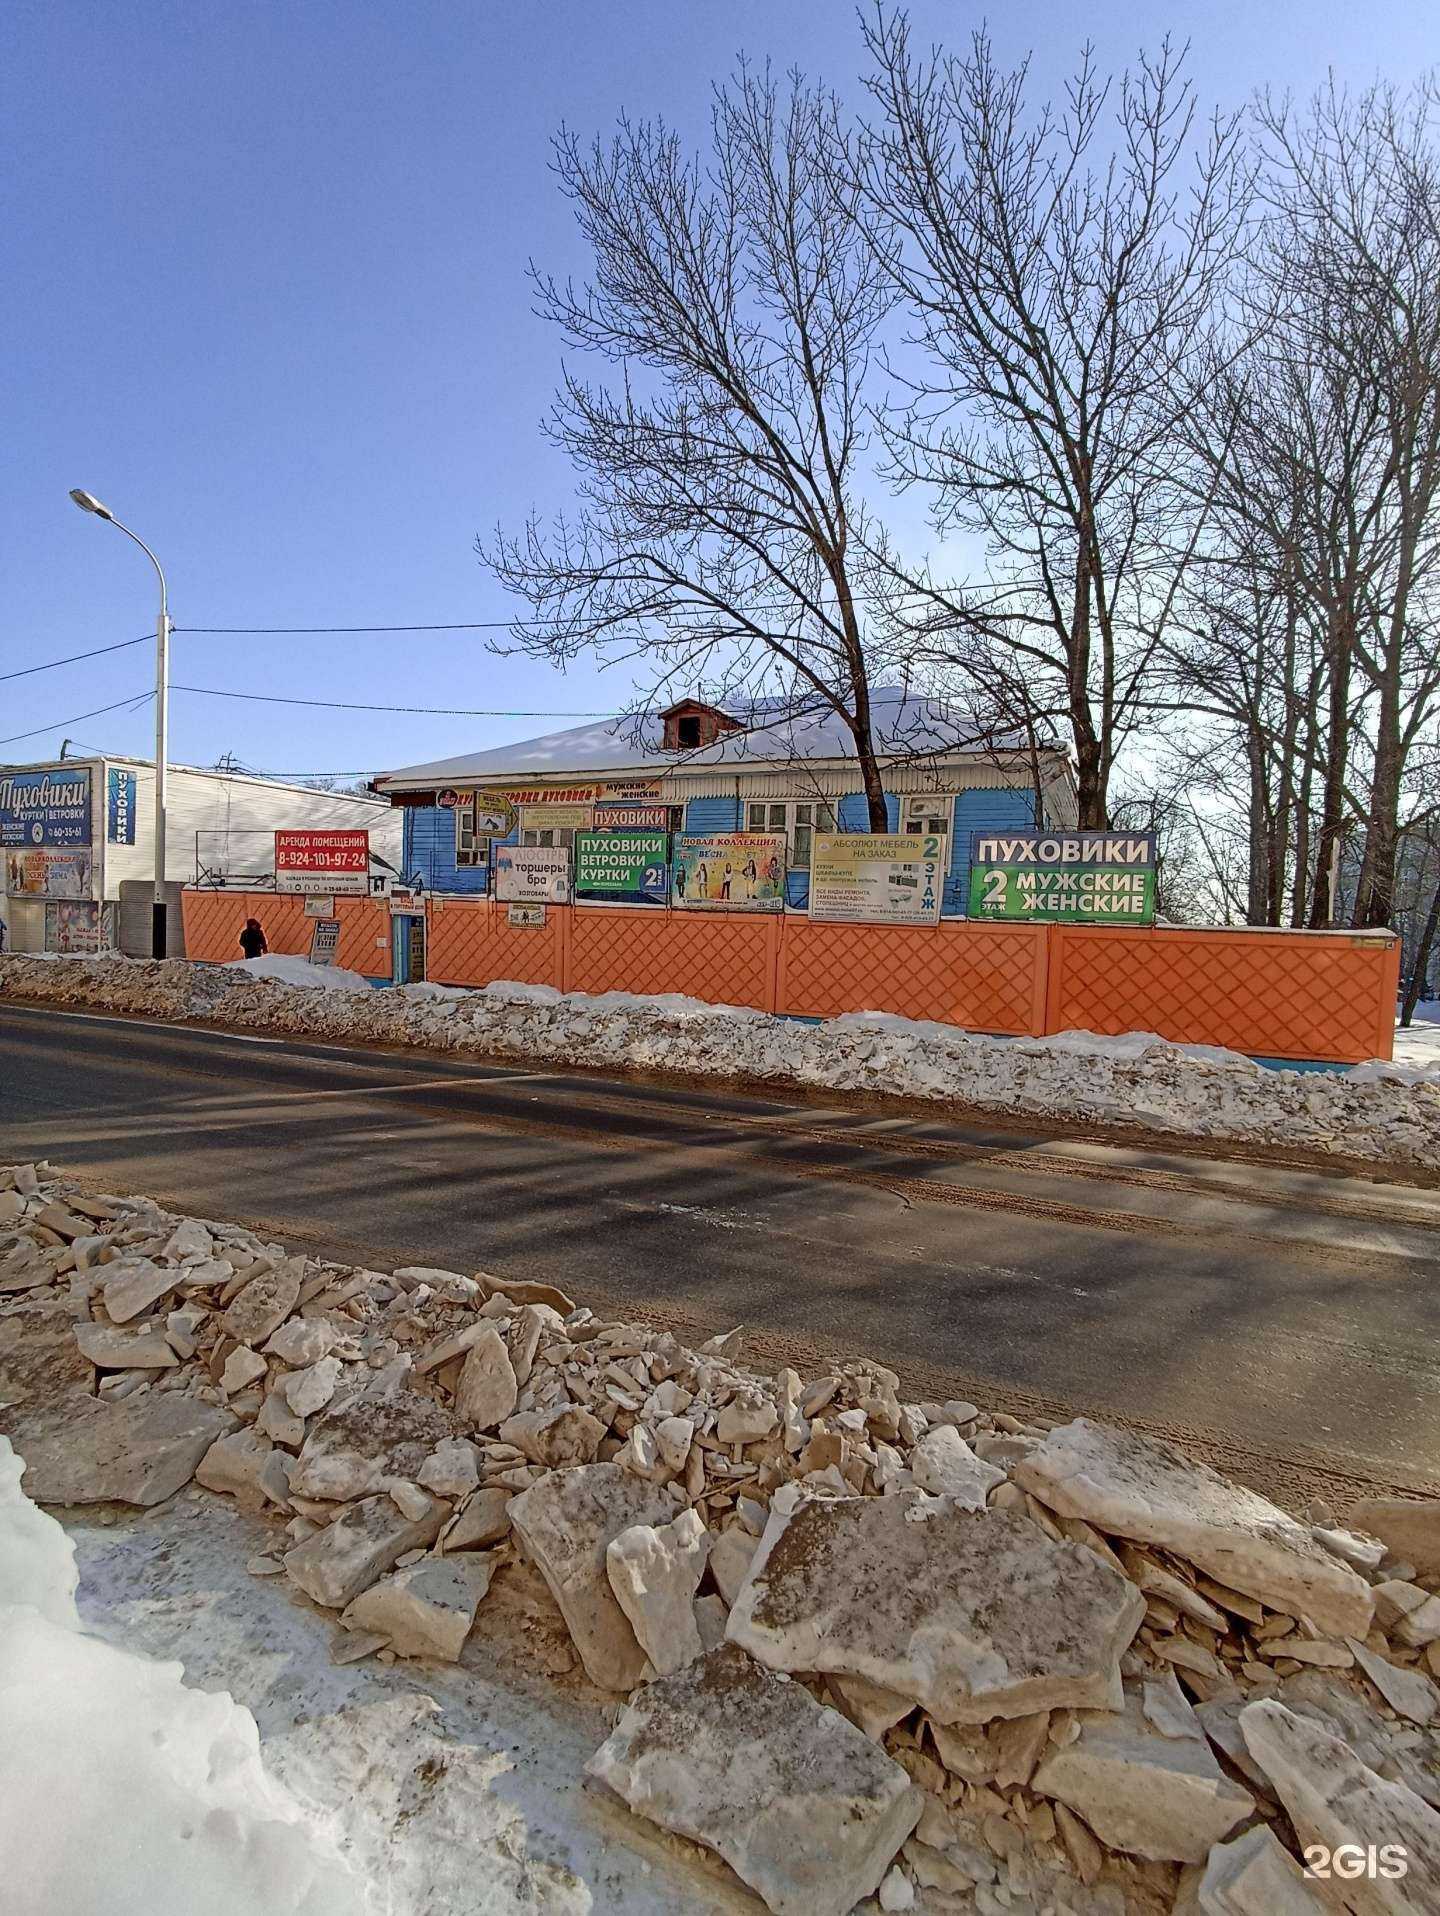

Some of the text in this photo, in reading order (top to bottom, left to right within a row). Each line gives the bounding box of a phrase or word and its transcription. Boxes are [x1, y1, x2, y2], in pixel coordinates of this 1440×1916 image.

[0, 775, 84, 818] Пуховики
[116, 772, 128, 843] ПУХОВИКИ
[595, 810, 664, 825] ПУХОВИКИ
[280, 836, 365, 848] АРЕНДА ПОМЕЩЕНИЙ
[581, 840, 662, 852] ПУХОВИКИ
[683, 838, 776, 846] НОВАЯ КОЛЛЕКЦИЯ
[833, 840, 919, 848] АБСОЛЮТ МЕБЕЛЬ
[922, 837, 939, 858] 2
[853, 850, 897, 858] НА ЗАКАЗ
[978, 839, 1148, 863] ПУХОВИКИ
[279, 852, 366, 866] 8-924-101-97-24
[581, 855, 646, 866] ВЕТРОВКИ
[515, 863, 566, 875] торшеры
[581, 869, 630, 881] КУРТКИ
[527, 874, 547, 885] бра
[645, 868, 658, 887] 2
[1016, 872, 1144, 891] МУЖСКИЕ
[921, 863, 936, 909] ЭТАЖ
[982, 870, 1008, 903] 2
[981, 903, 1005, 911] ЭТАЖ
[1021, 893, 1143, 913] ЖЕНСКИЕ
